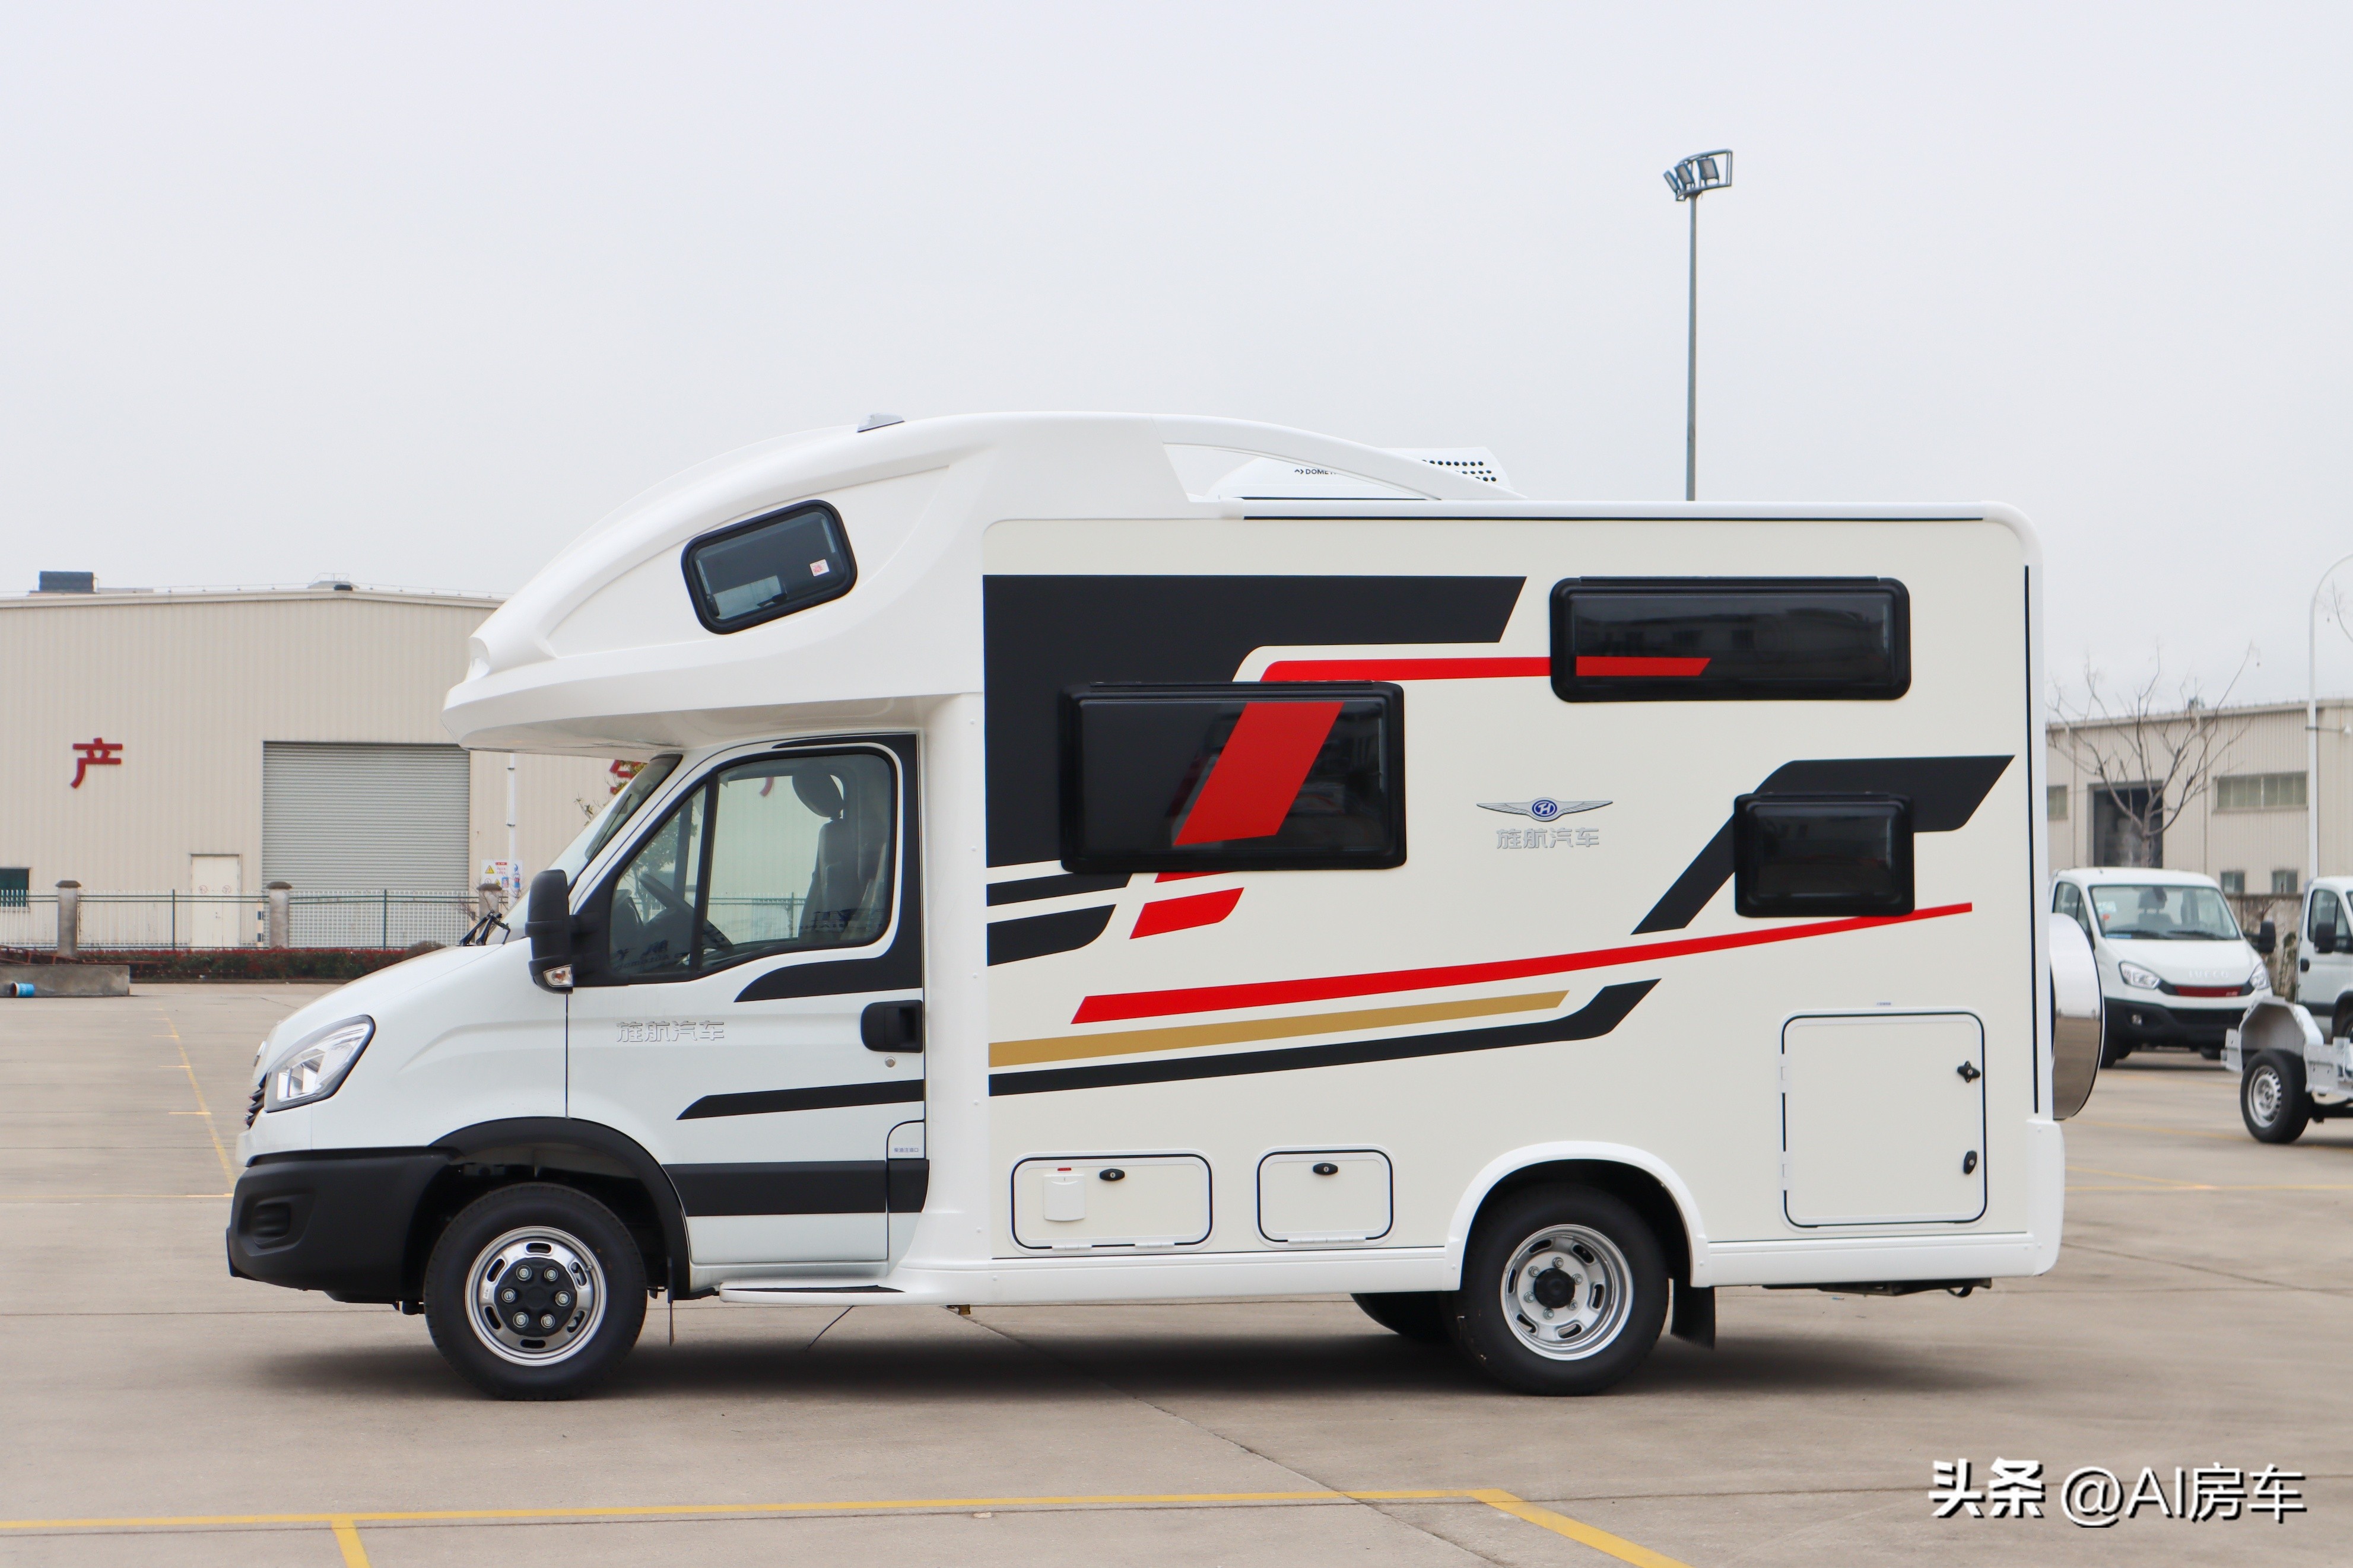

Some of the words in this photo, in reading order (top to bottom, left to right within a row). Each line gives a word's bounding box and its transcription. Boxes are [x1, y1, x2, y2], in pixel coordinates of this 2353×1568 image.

[70, 737, 122, 788] 产
[1496, 827, 1600, 850] 旌航汽车
[616, 1020, 725, 1042] 旌航汽车
